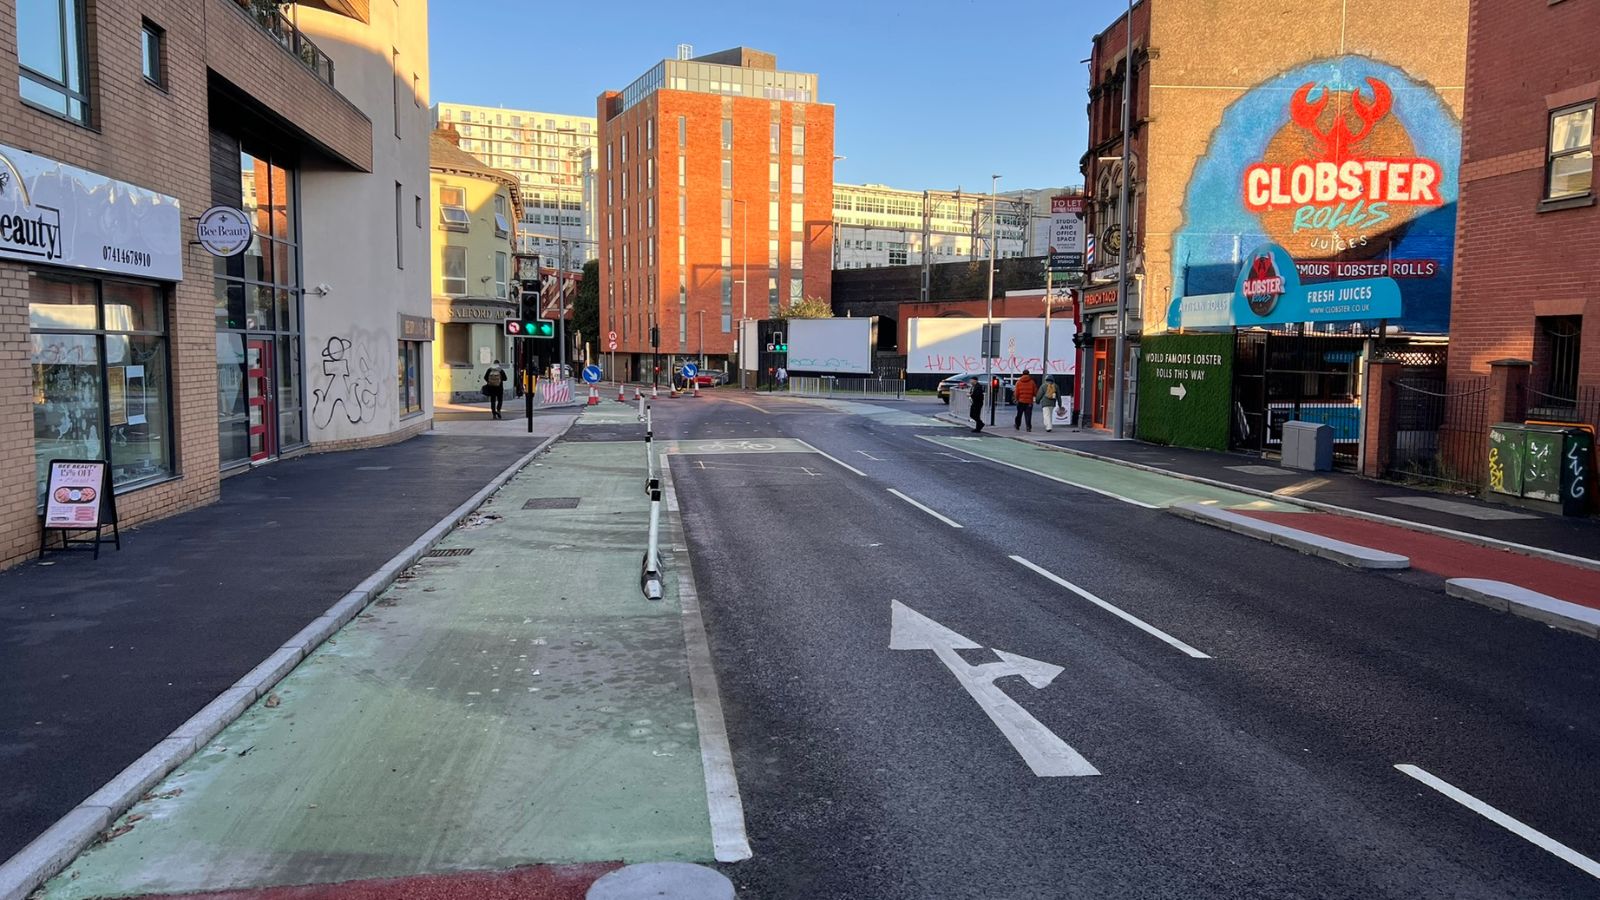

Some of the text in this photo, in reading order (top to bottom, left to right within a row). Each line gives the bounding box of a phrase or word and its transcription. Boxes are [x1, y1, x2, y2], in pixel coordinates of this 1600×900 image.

[1248, 160, 1436, 207] CLOBSTER
[1293, 199, 1390, 233] ROLLS
[0, 214, 58, 260] eauty
[200, 226, 247, 239] Bee Beauty
[1310, 234, 1368, 251] JUICES
[102, 245, 151, 268] 07414678910
[1296, 264, 1330, 276] MOUS
[1392, 263, 1434, 276] ROLLS
[1242, 278, 1282, 296] CLOBSTER
[1307, 286, 1372, 303] FRESH JUICES
[1085, 294, 1101, 304] FRENCH
[448, 307, 493, 319] SALFORD
[1145, 353, 1222, 365] WORLD FAMOUS LOBSTER
[1156, 368, 1205, 380] ROLLS THIS WAY
